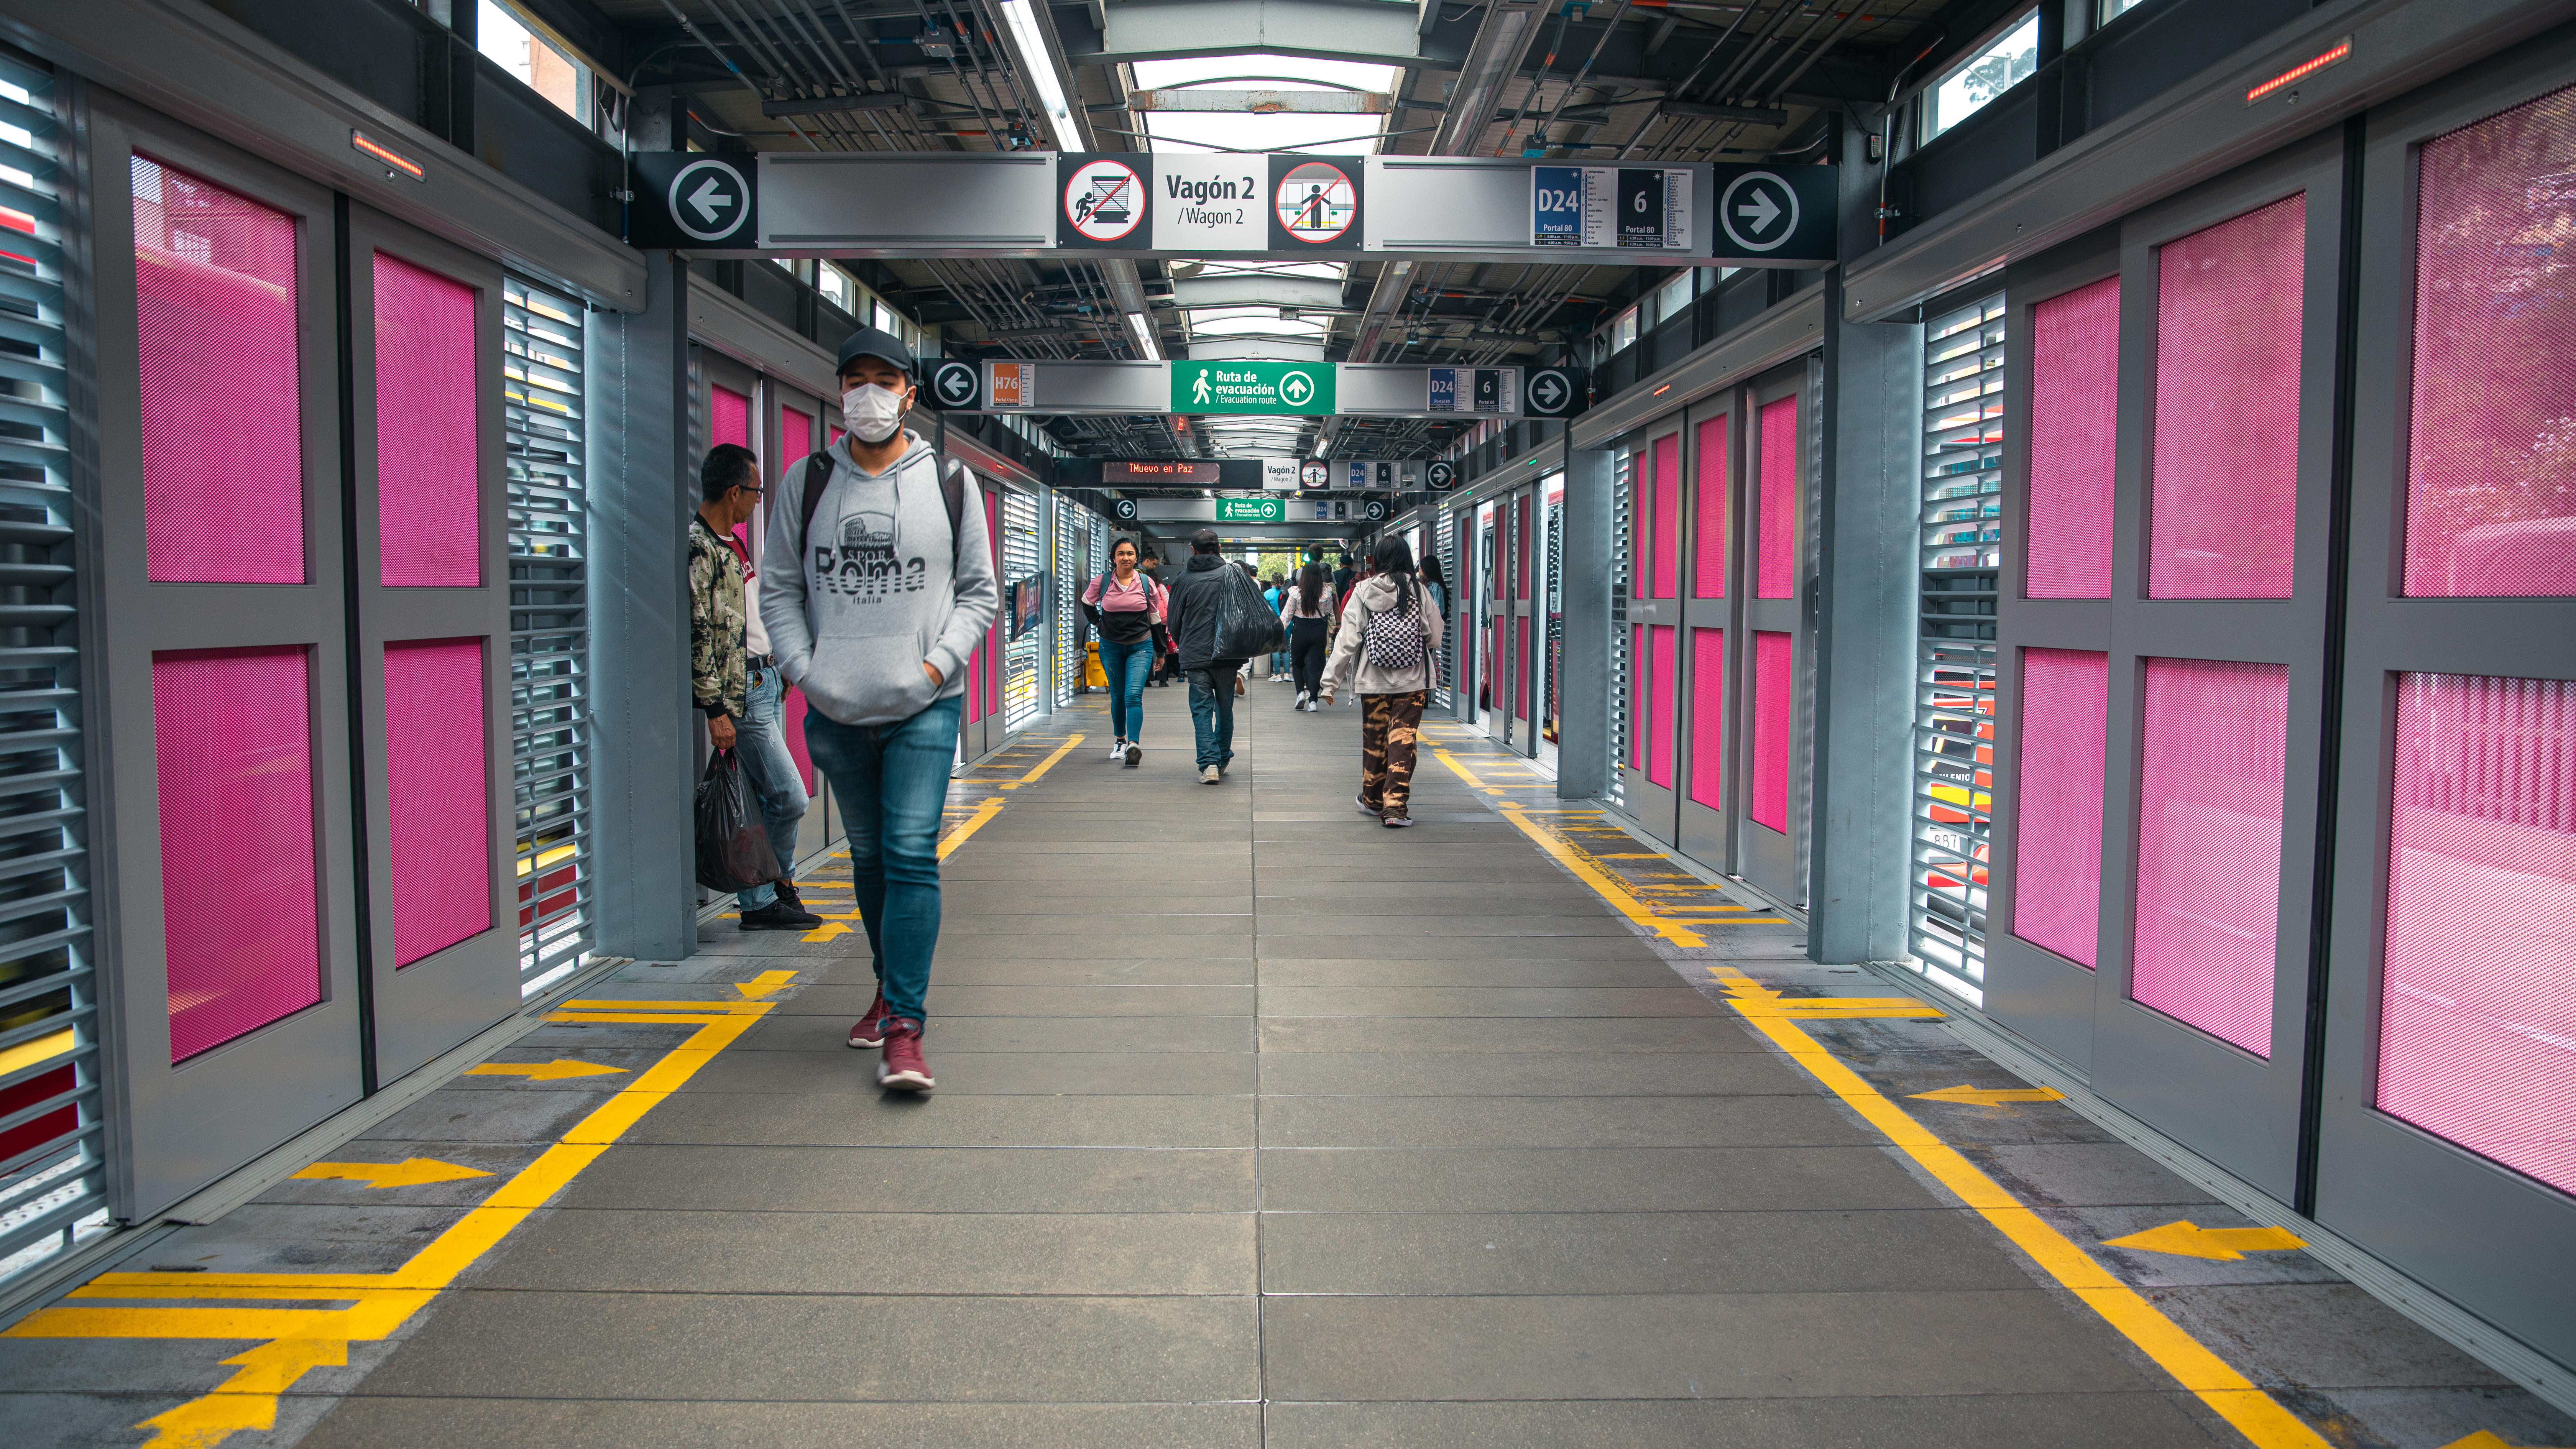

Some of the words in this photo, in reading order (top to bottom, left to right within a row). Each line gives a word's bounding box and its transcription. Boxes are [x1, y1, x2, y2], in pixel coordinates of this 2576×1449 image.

[1166, 175, 1236, 205] Vagón
[1242, 176, 1254, 199] 2
[1539, 189, 1579, 212] D24
[1634, 191, 1646, 213] 6
[1236, 209, 1243, 224] 2
[1216, 370, 1241, 382] Ruta
[1244, 371, 1257, 382] de
[996, 376, 1018, 389] H76
[1431, 381, 1454, 393] D24
[1484, 381, 1490, 393] 6
[1216, 383, 1275, 395] evacuación
[1129, 463, 1158, 473] TMuevo
[1178, 463, 1193, 473] Paz
[1268, 466, 1290, 476] Vagón
[815, 546, 925, 595] Roma
[853, 596, 882, 605] italia
